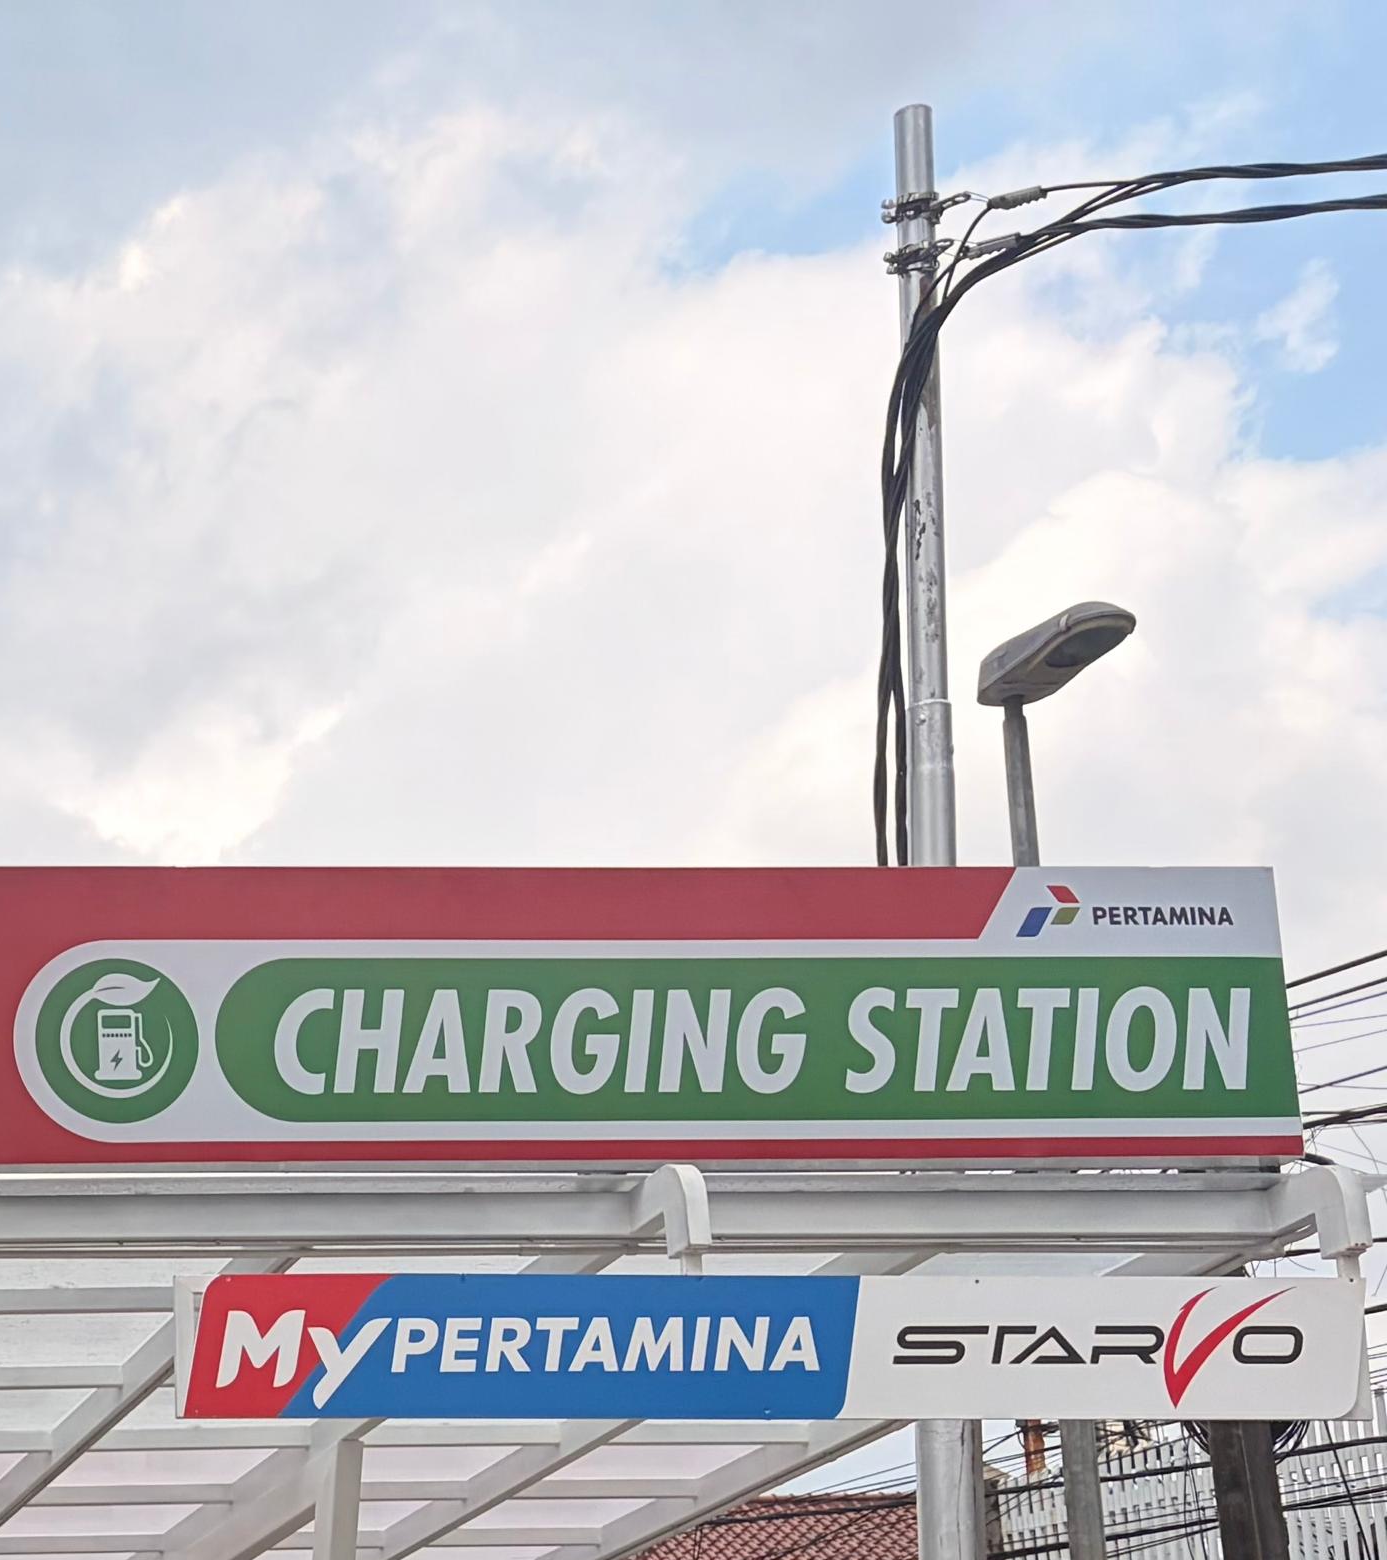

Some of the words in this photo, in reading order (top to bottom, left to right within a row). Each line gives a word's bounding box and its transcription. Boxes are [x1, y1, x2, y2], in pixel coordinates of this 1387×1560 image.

[1091, 905, 1235, 927] PERTAMINA
[273, 987, 807, 1096] CHARGING
[844, 985, 1251, 1094] STATION
[892, 1286, 1304, 1410] STARVO
